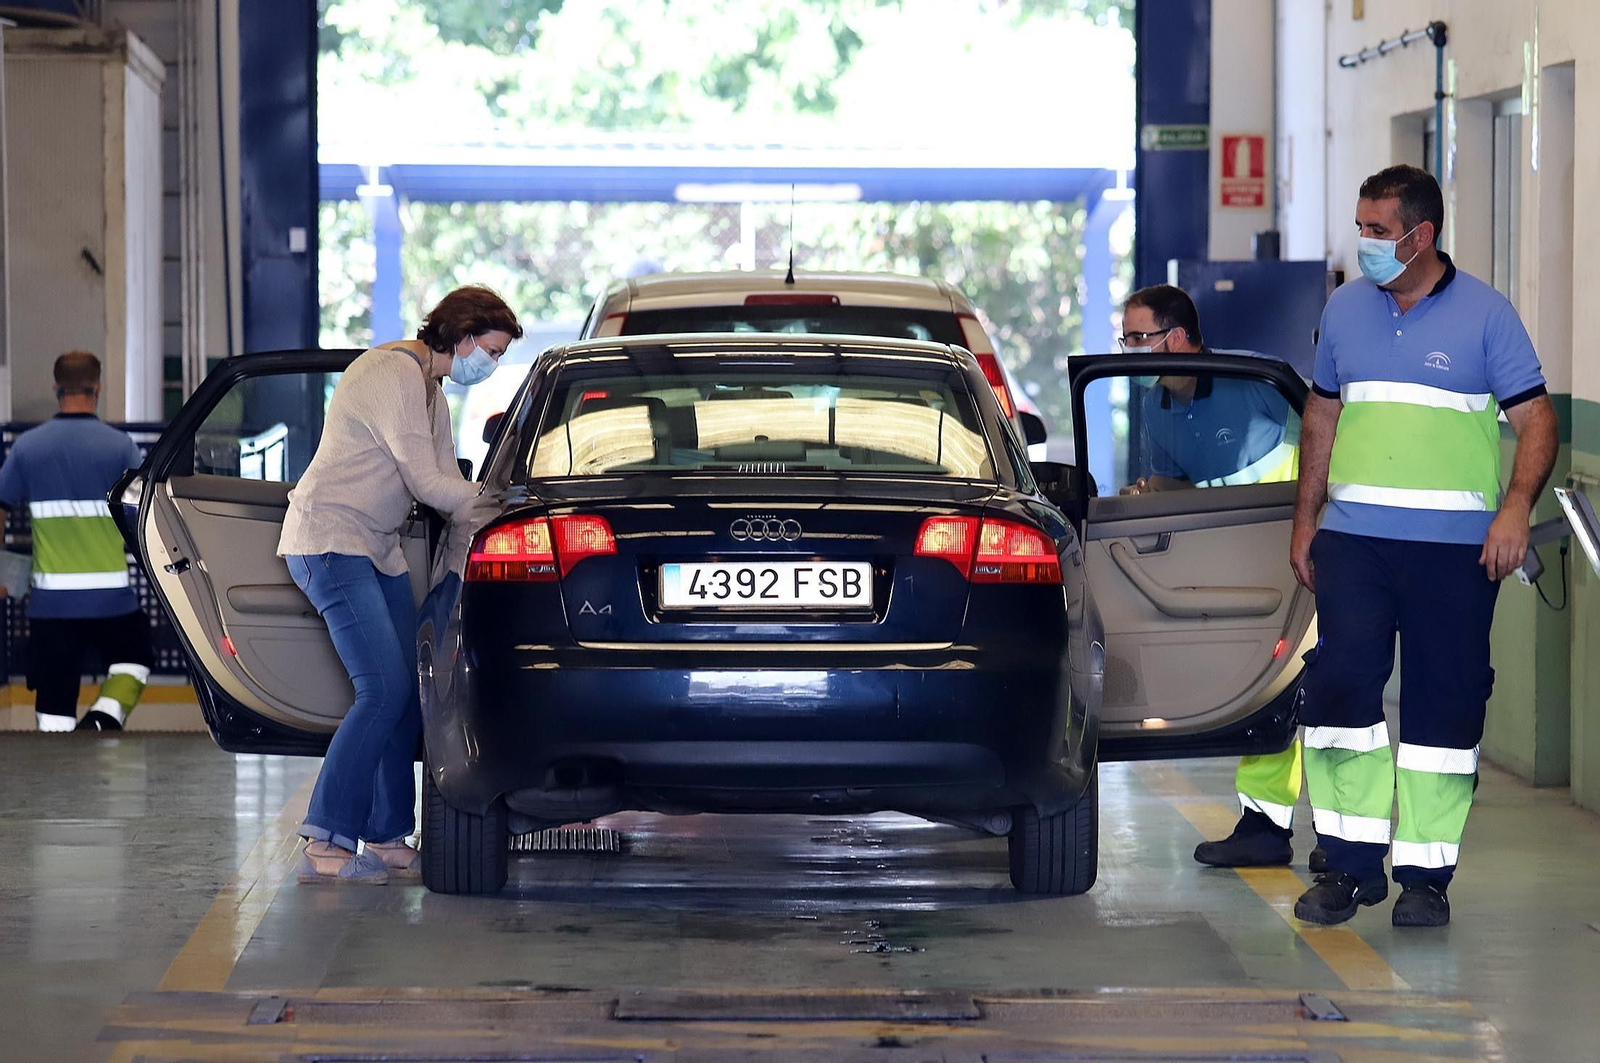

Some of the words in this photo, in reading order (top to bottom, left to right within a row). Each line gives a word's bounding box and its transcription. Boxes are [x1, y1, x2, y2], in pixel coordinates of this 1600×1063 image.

[689, 568, 779, 599] 4392
[793, 568, 861, 598] FSB
[579, 600, 611, 615] A4
